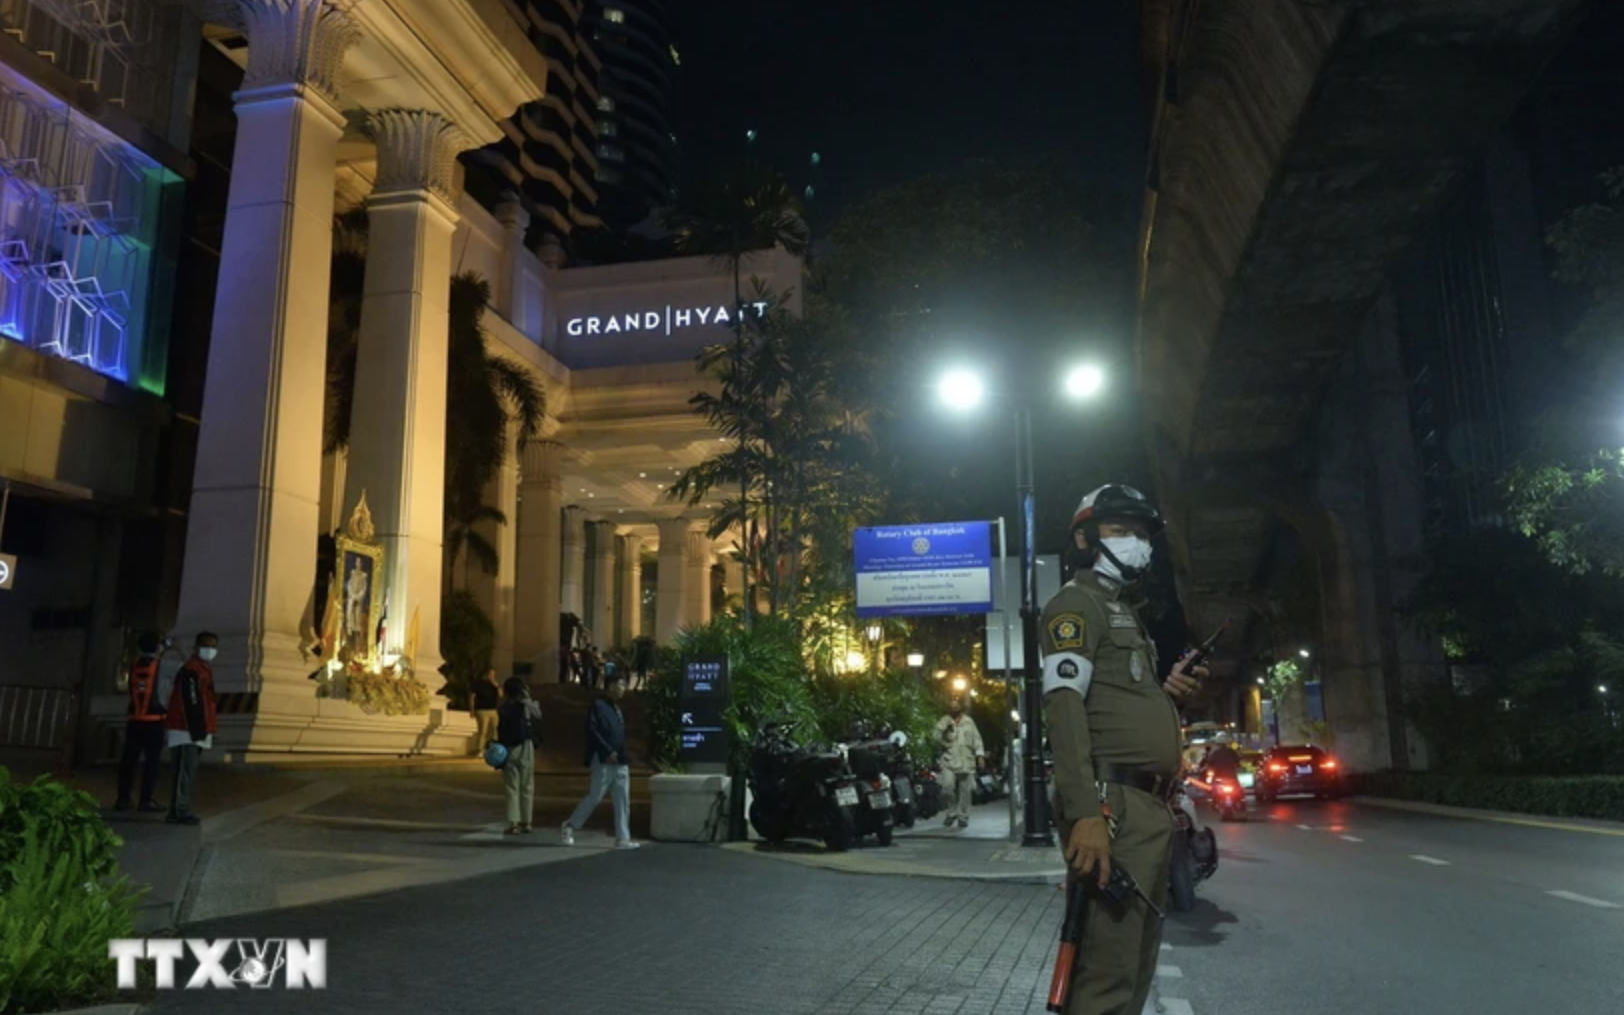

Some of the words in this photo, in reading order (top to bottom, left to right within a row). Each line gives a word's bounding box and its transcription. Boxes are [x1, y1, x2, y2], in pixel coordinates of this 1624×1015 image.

[566, 311, 661, 336] GRAND
[876, 530, 901, 539] Rotary
[903, 528, 923, 537] Club
[923, 528, 932, 536] of
